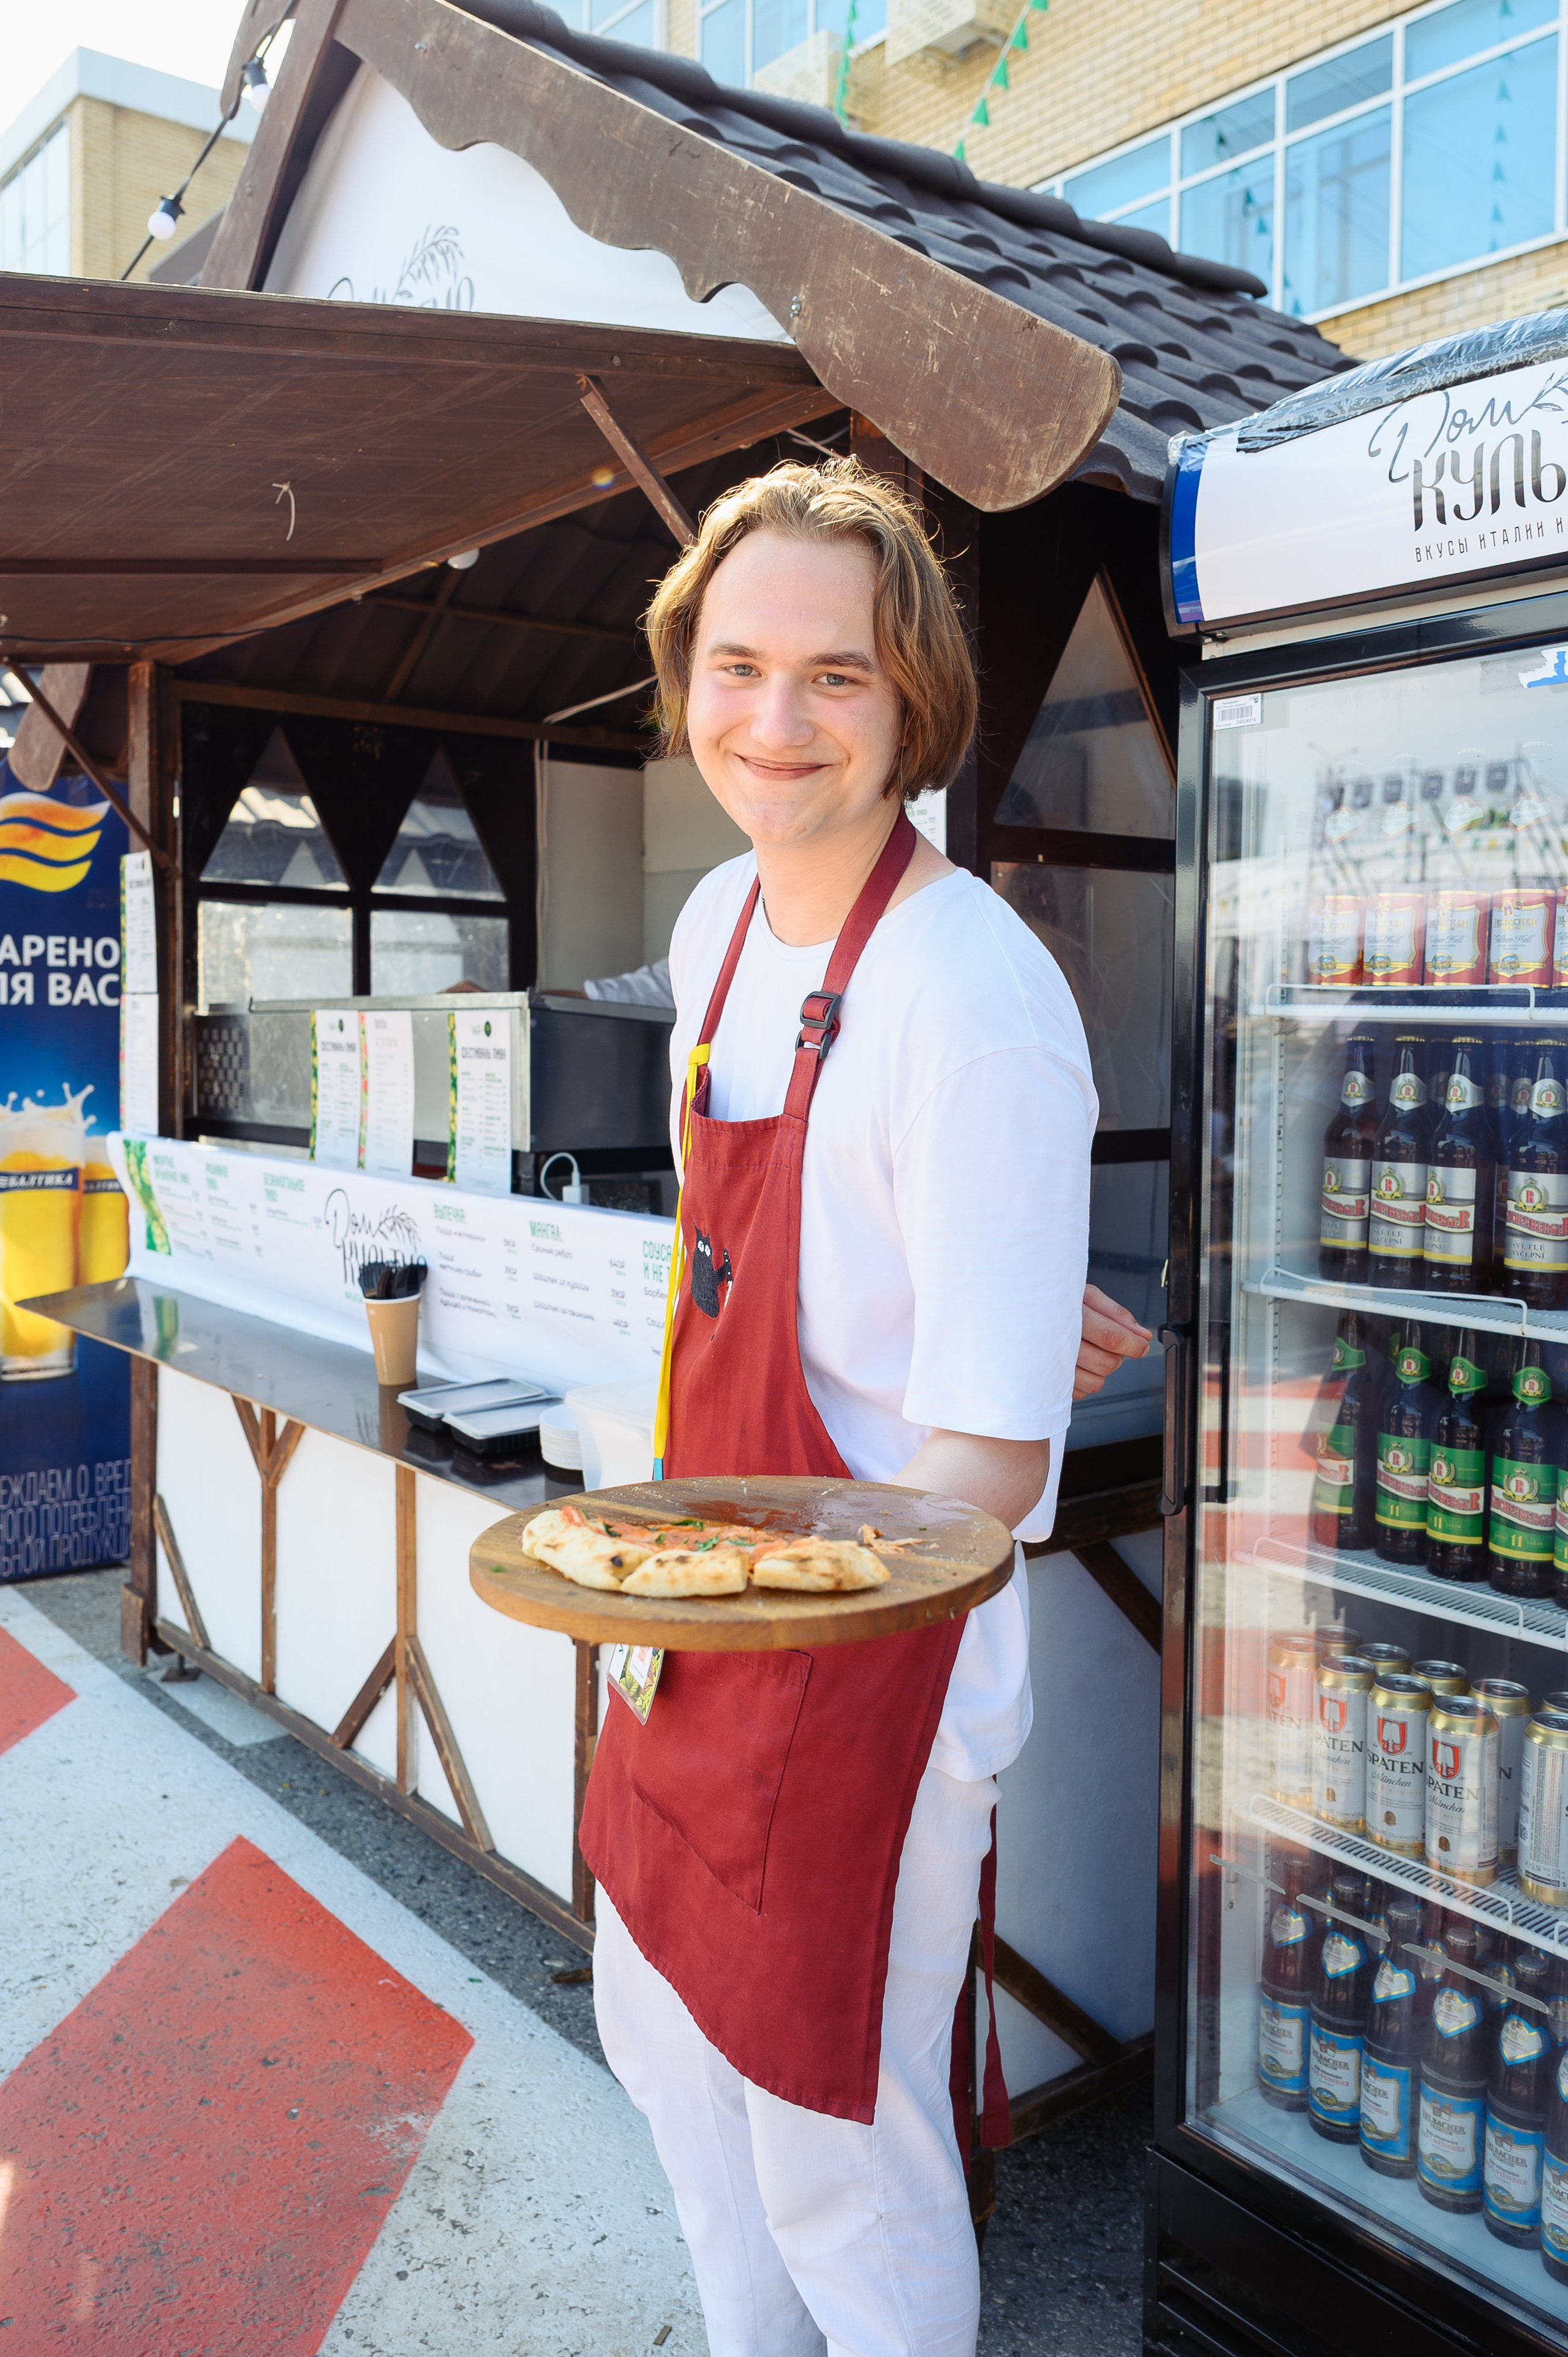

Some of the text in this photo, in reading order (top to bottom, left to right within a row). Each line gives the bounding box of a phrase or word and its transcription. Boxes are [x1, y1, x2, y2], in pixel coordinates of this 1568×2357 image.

[1415, 538, 1468, 562] ВКУСЫ
[1479, 521, 1545, 549] ИТАЛИИ
[48, 972, 120, 1006] ВАС
[1327, 1174, 1332, 1185] R
[1385, 1179, 1392, 1191] R
[1430, 1183, 1434, 1196] R
[1526, 1190, 1534, 1203] R
[530, 1220, 564, 1242] МАНГАЛ:
[653, 1265, 663, 1283] НЕ
[1392, 1452, 1400, 1466] R
[1437, 1463, 1443, 1477] R
[77, 1463, 90, 1499] О
[1515, 1479, 1524, 1493] R
[1511, 1534, 1523, 1548] 11
[1366, 1748, 1425, 1774] SPATEN
[1371, 1771, 1412, 1787] München
[1428, 1795, 1465, 1814] München
